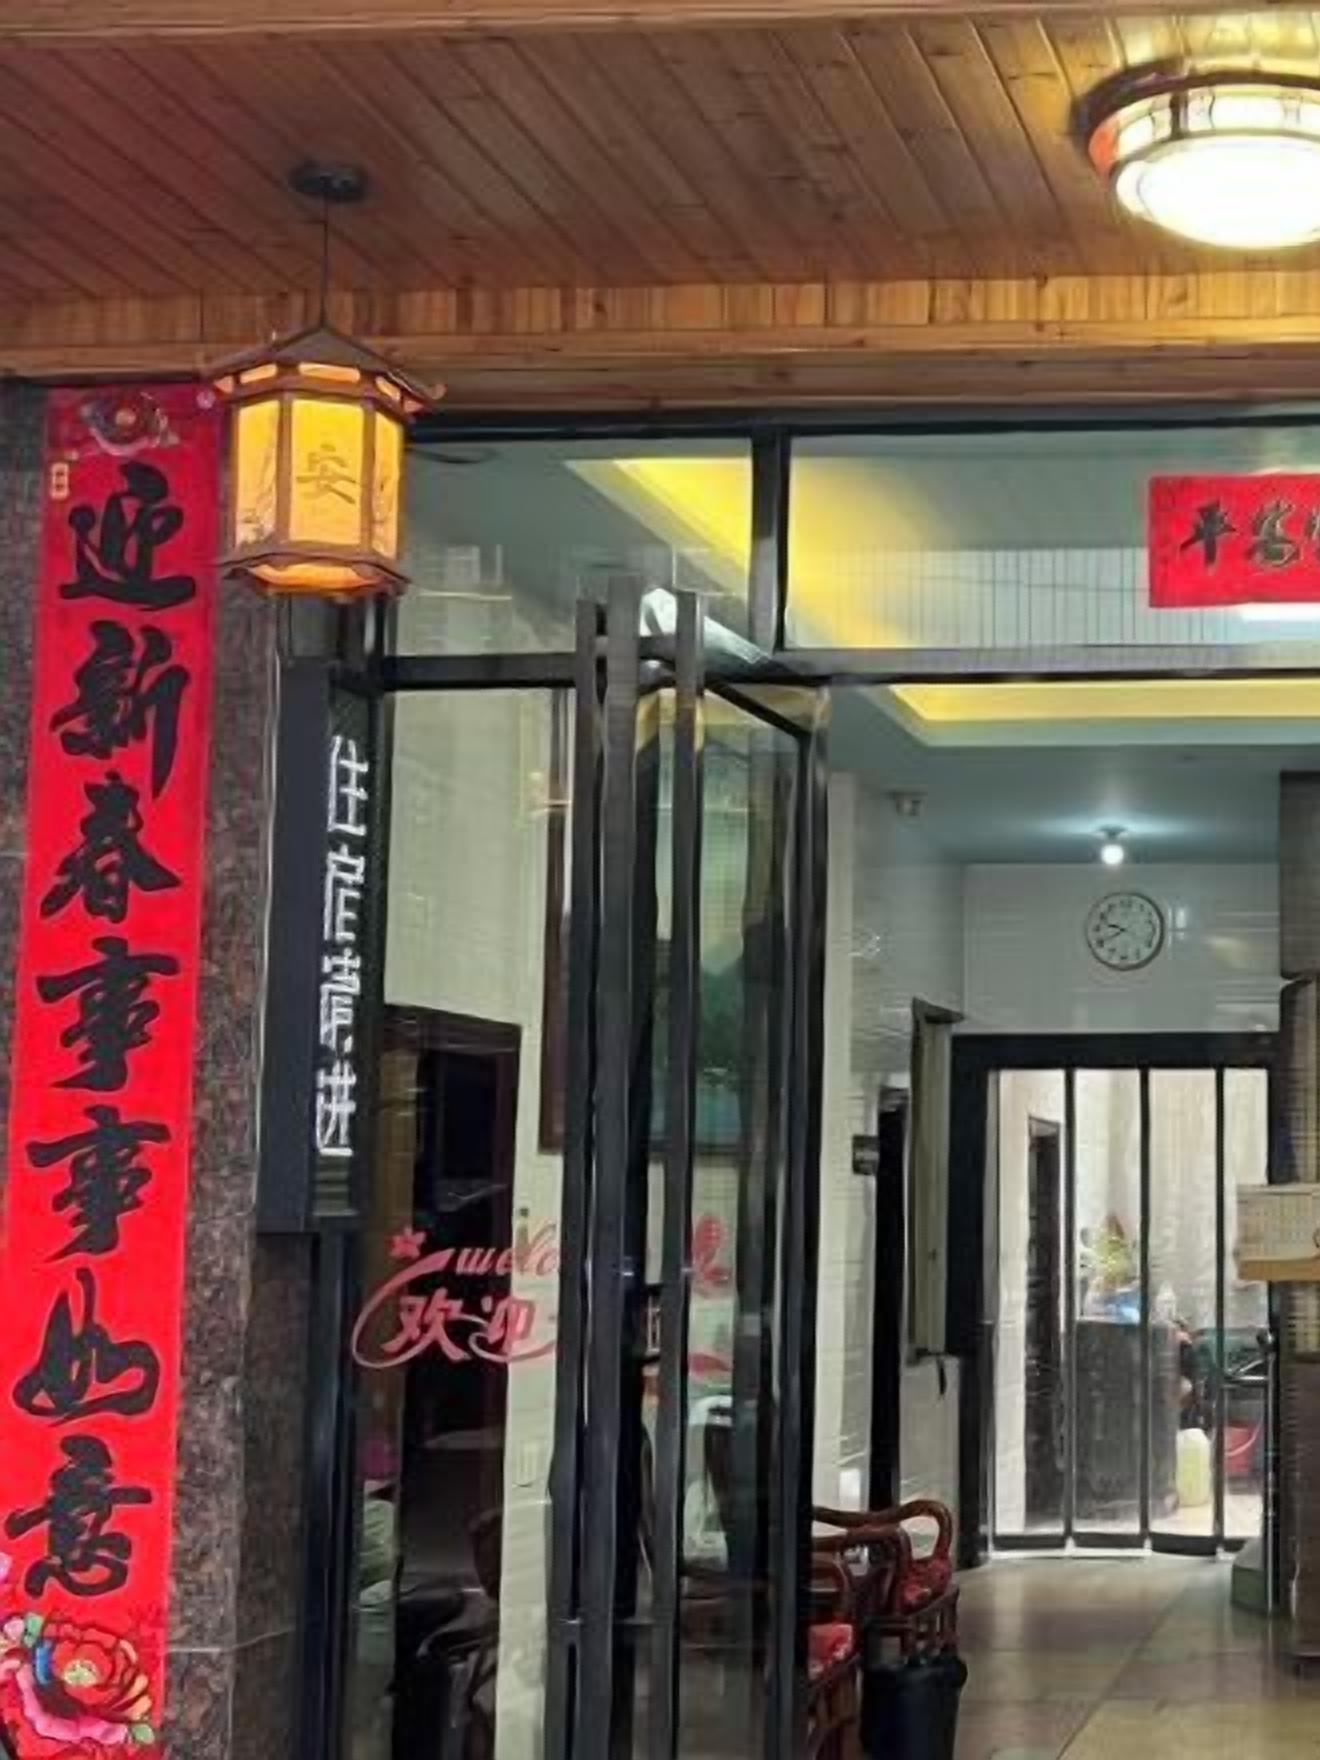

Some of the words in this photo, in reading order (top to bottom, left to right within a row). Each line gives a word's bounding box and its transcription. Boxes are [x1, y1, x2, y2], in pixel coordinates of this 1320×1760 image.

[3, 460, 197, 1599] 迎新春事事如意
[382, 1286, 541, 1364] 欢迎
